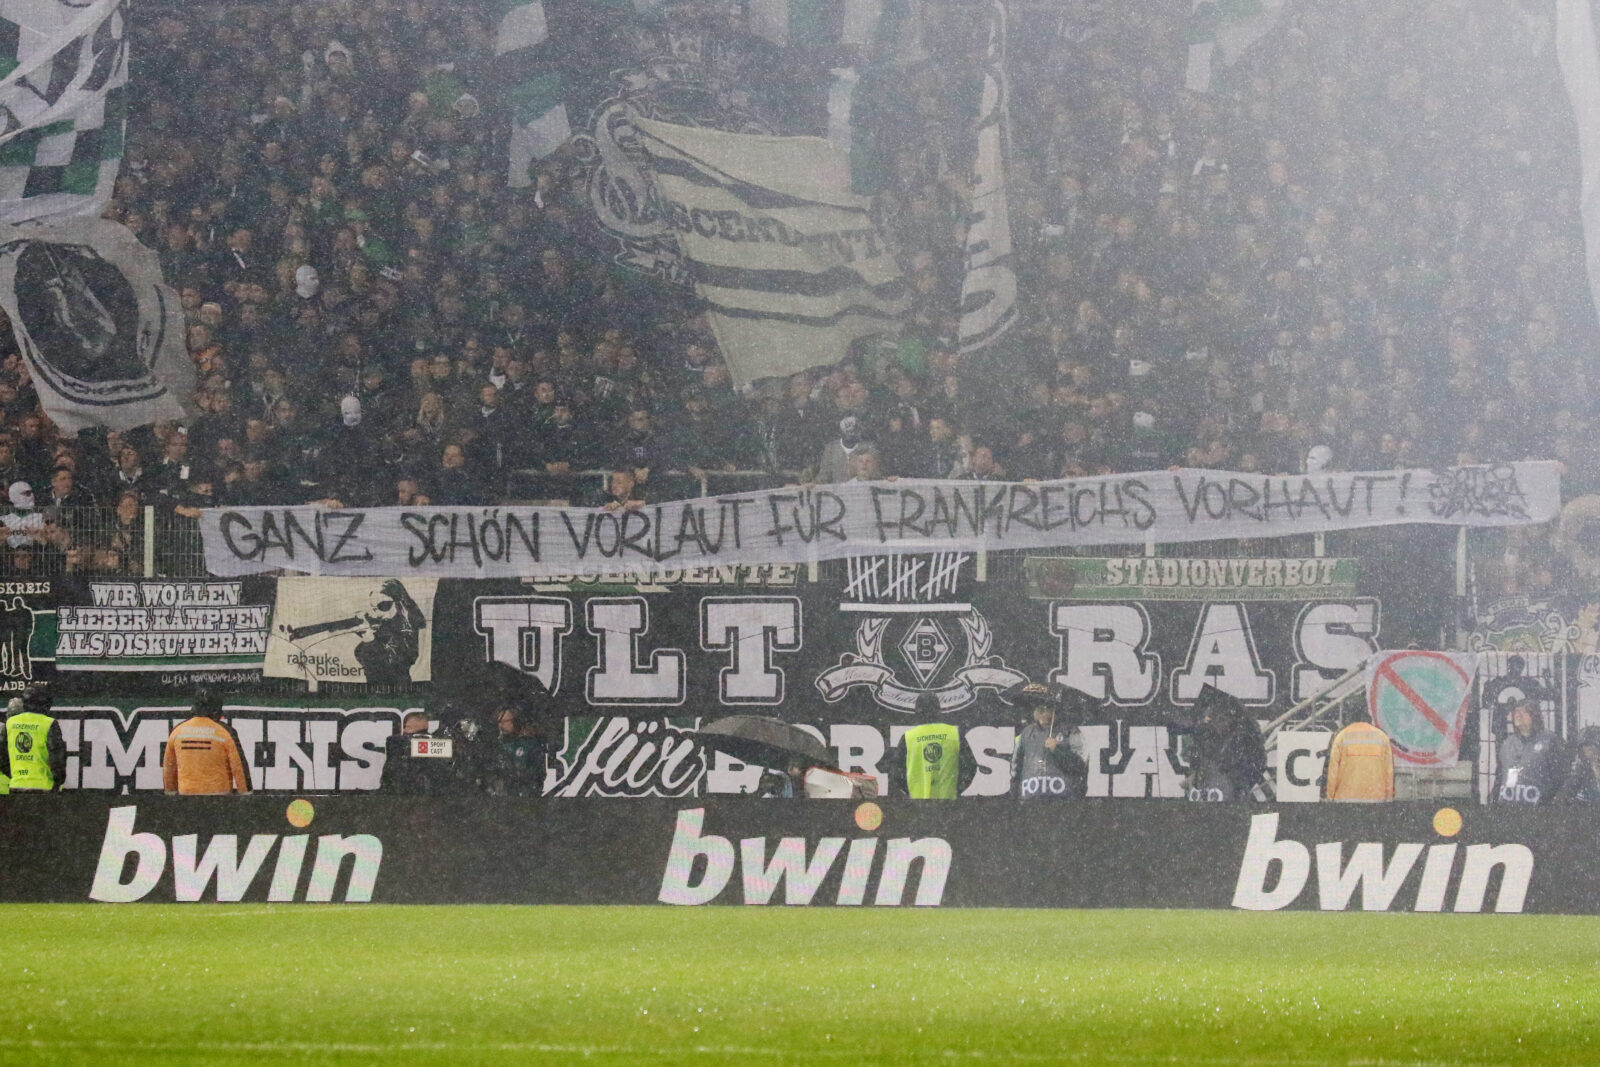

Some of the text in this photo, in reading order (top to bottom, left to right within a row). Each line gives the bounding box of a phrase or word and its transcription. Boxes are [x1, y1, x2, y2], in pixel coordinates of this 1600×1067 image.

[219, 510, 374, 564] GANZ
[400, 507, 541, 568] SCHÖN
[560, 498, 755, 562] VORLAUT
[767, 490, 848, 548] FÜR
[1173, 471, 1412, 524] VORHAUT!
[1105, 558, 1338, 588] STADIONVERBOT
[90, 582, 242, 607] WIR WOLLEN
[58, 606, 270, 632] LIEBER KÄMPFEN
[56, 632, 269, 656] ALS DISKUTIEREN
[287, 653, 340, 666] rabauke
[430, 741, 447, 749] SPORT
[1021, 775, 1066, 797] FOTO
[88, 799, 383, 904] bwin
[657, 802, 952, 907] bwin
[1230, 807, 1535, 914] bwin
